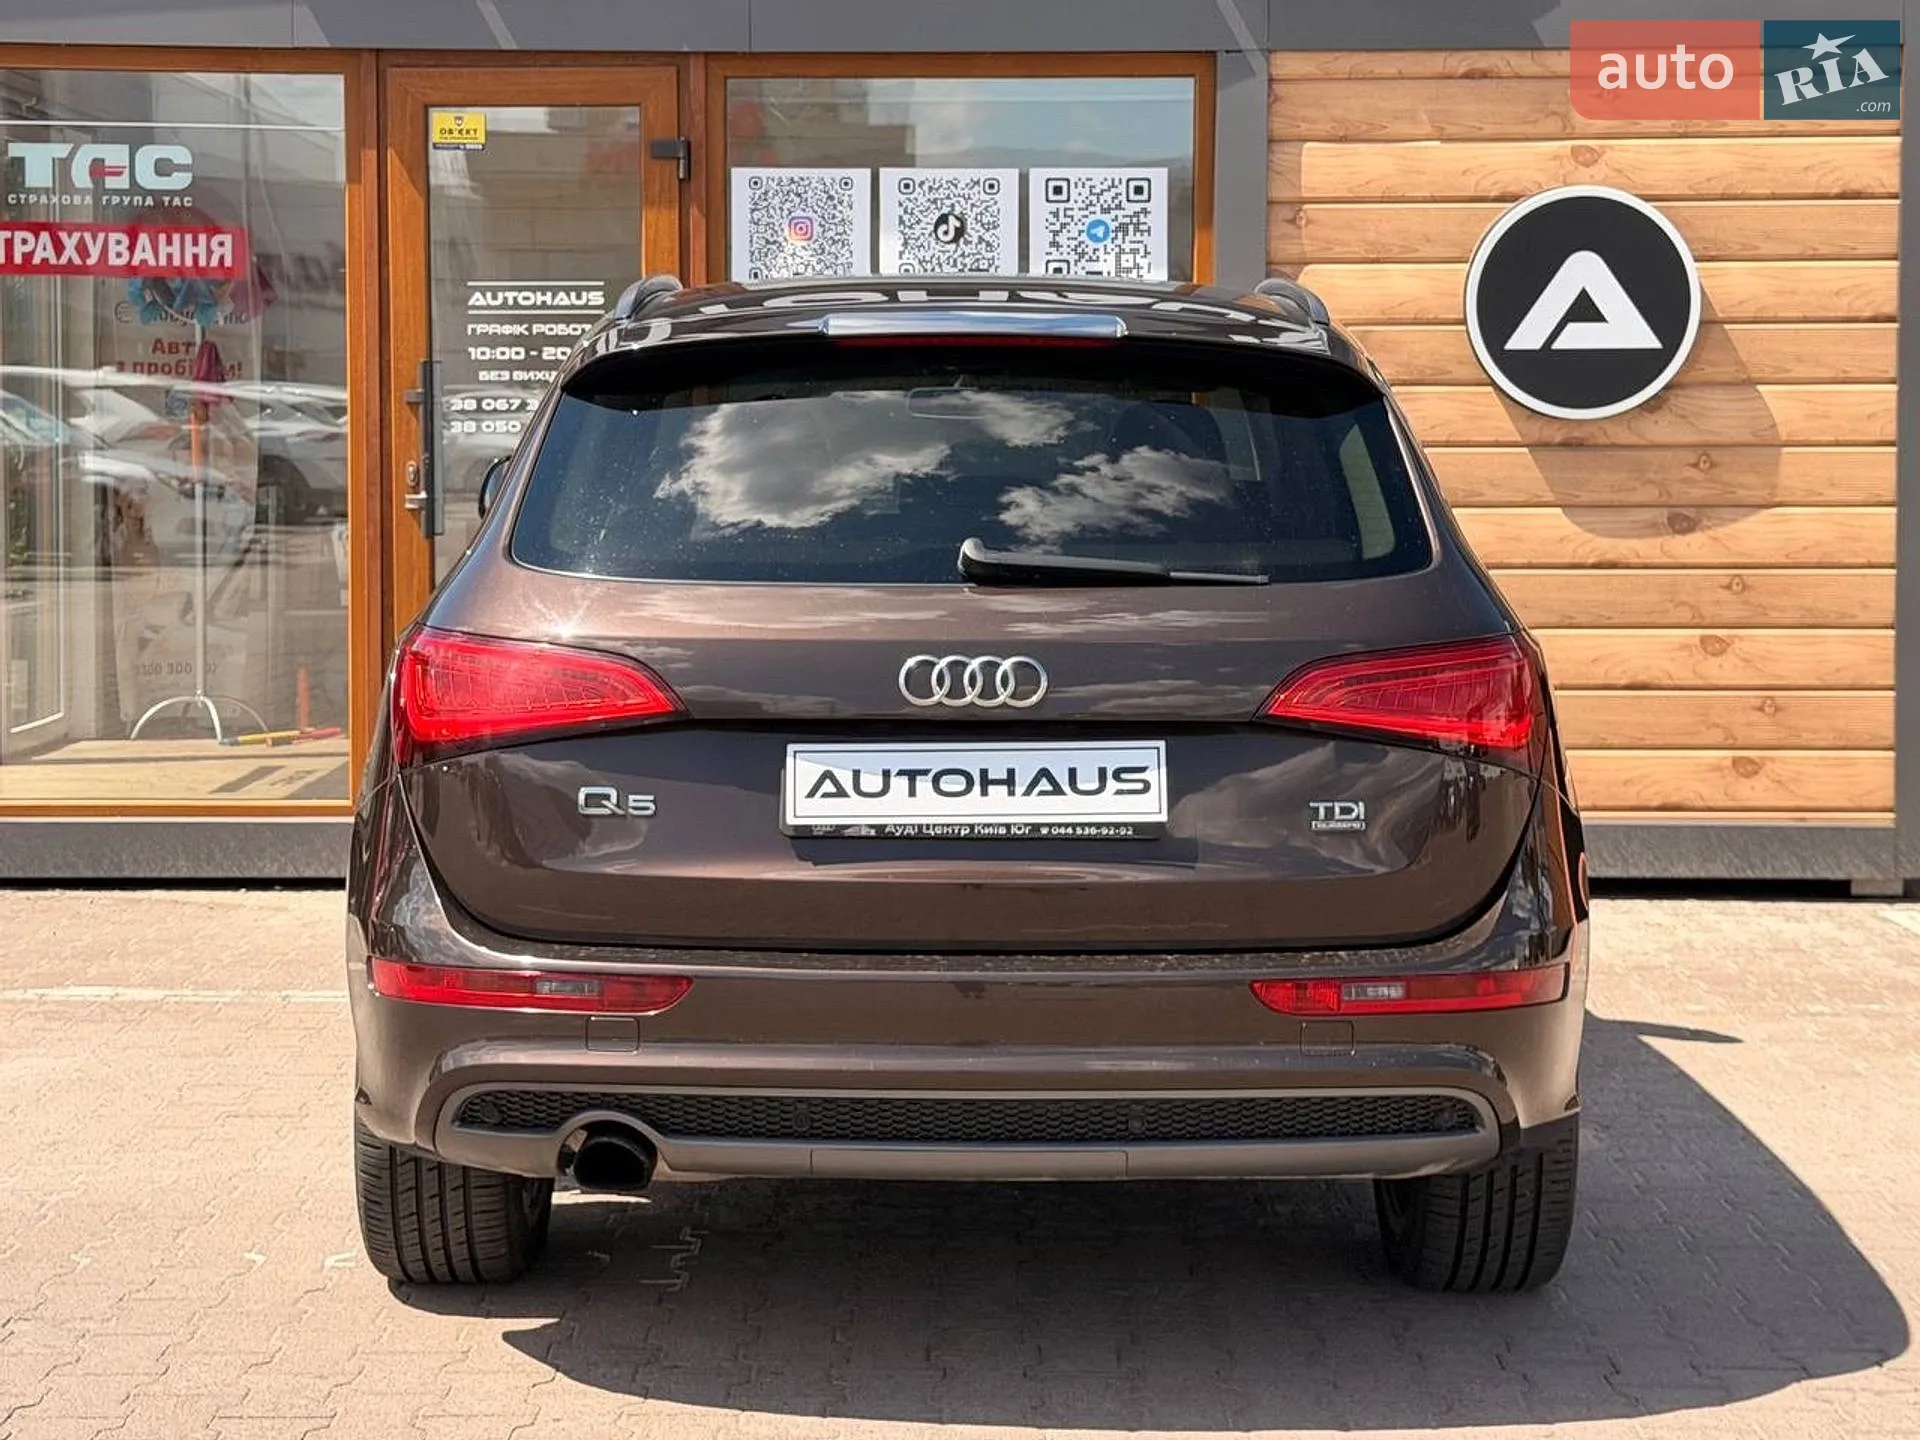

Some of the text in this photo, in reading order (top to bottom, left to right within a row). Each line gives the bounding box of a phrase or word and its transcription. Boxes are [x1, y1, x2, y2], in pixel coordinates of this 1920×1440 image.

[7, 193, 193, 208] СТРАХОВА ГРУПА ТАС
[467, 290, 606, 306] AUTOHAUS
[467, 323, 529, 336] ГРАФІК
[151, 337, 197, 355] Авт
[467, 346, 526, 361] 10:00
[478, 370, 510, 382] БЕЗ
[481, 398, 522, 411] 067
[481, 420, 522, 433] 050
[804, 766, 1152, 799] AUTOHAUS
[577, 786, 656, 816] Q5
[1309, 801, 1366, 820] TDI
[884, 823, 918, 836] Ауді
[922, 823, 970, 837] Центр
[974, 823, 1007, 835] Київ
[1010, 823, 1032, 835] Юг
